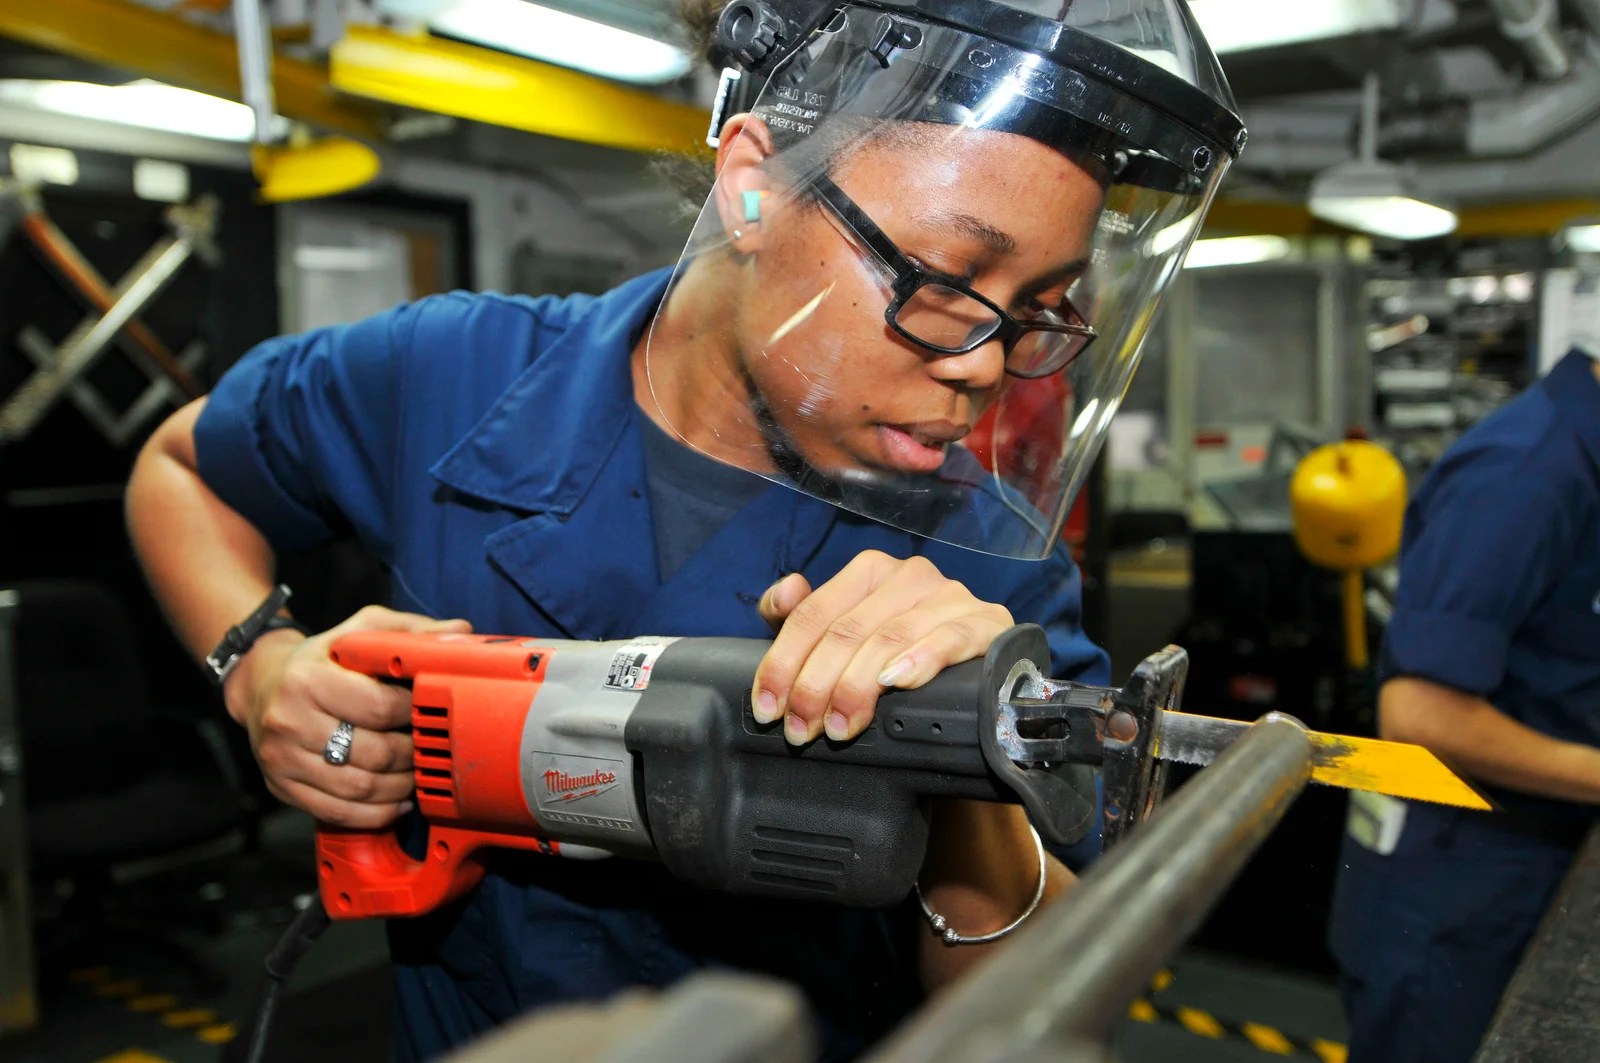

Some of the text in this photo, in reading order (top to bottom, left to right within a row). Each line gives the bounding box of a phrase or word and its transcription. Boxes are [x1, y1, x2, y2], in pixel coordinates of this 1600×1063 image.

[541, 768, 617, 794] Milwaukee
[547, 813, 631, 830] HEAVY DUTY
